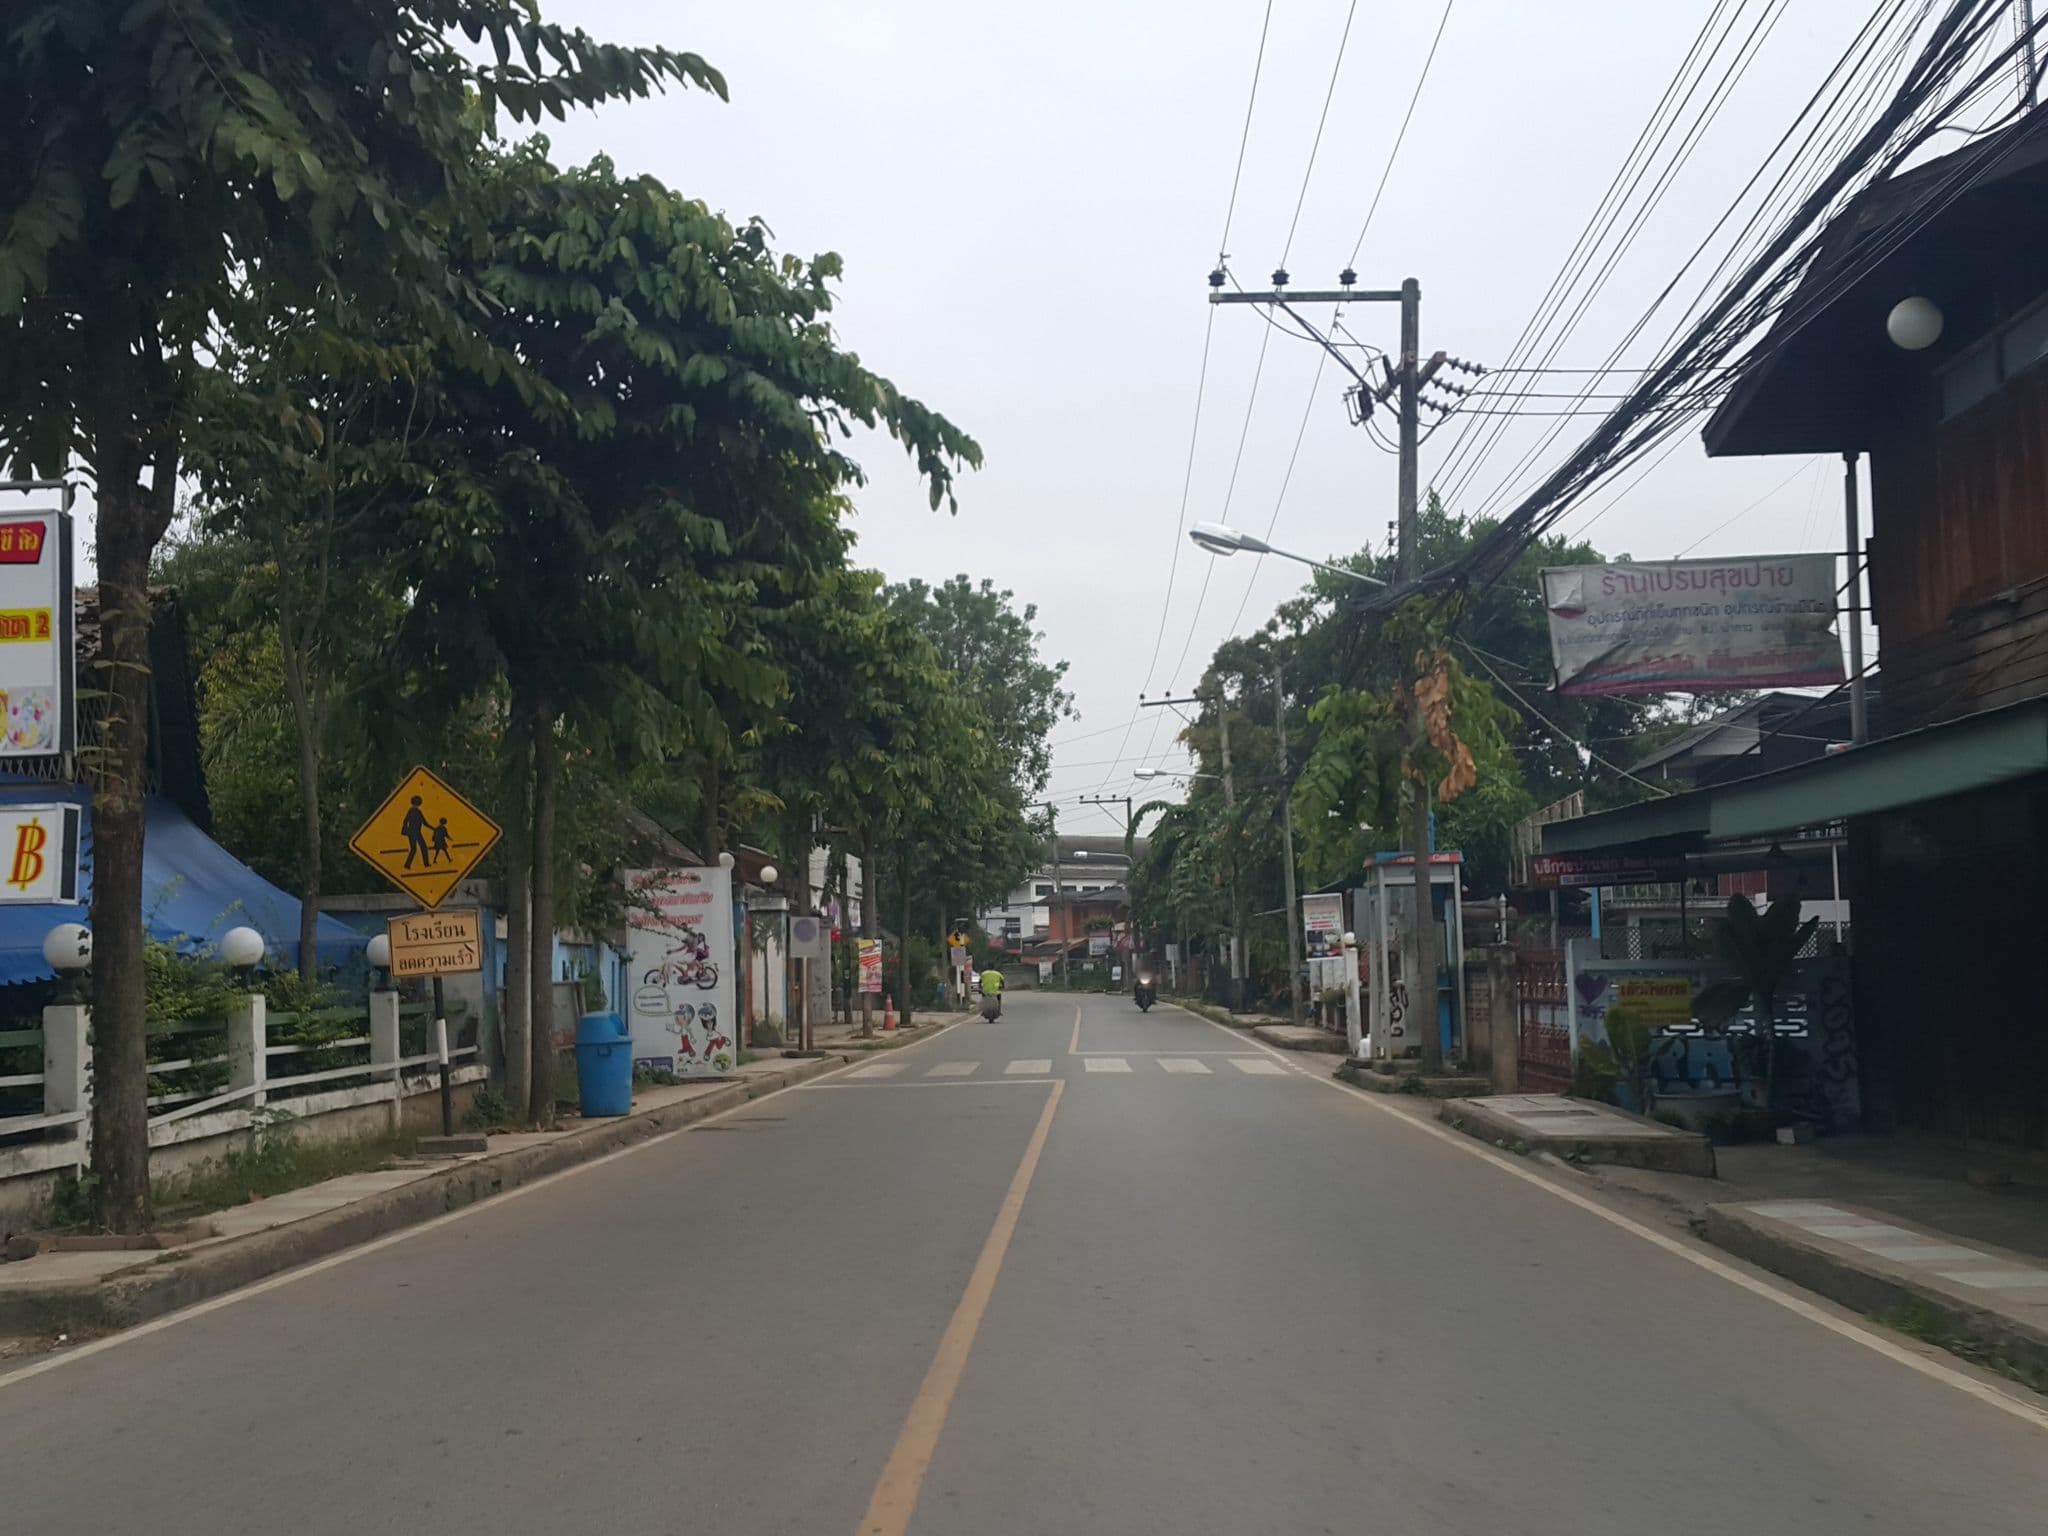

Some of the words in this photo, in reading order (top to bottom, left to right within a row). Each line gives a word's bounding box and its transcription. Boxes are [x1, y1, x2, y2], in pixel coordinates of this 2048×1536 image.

[1602, 562, 1794, 597] ร้านเปรมสุขปาย
[402, 919, 466, 941] โรงเรียน
[399, 948, 474, 971] ลดความเร็ว
